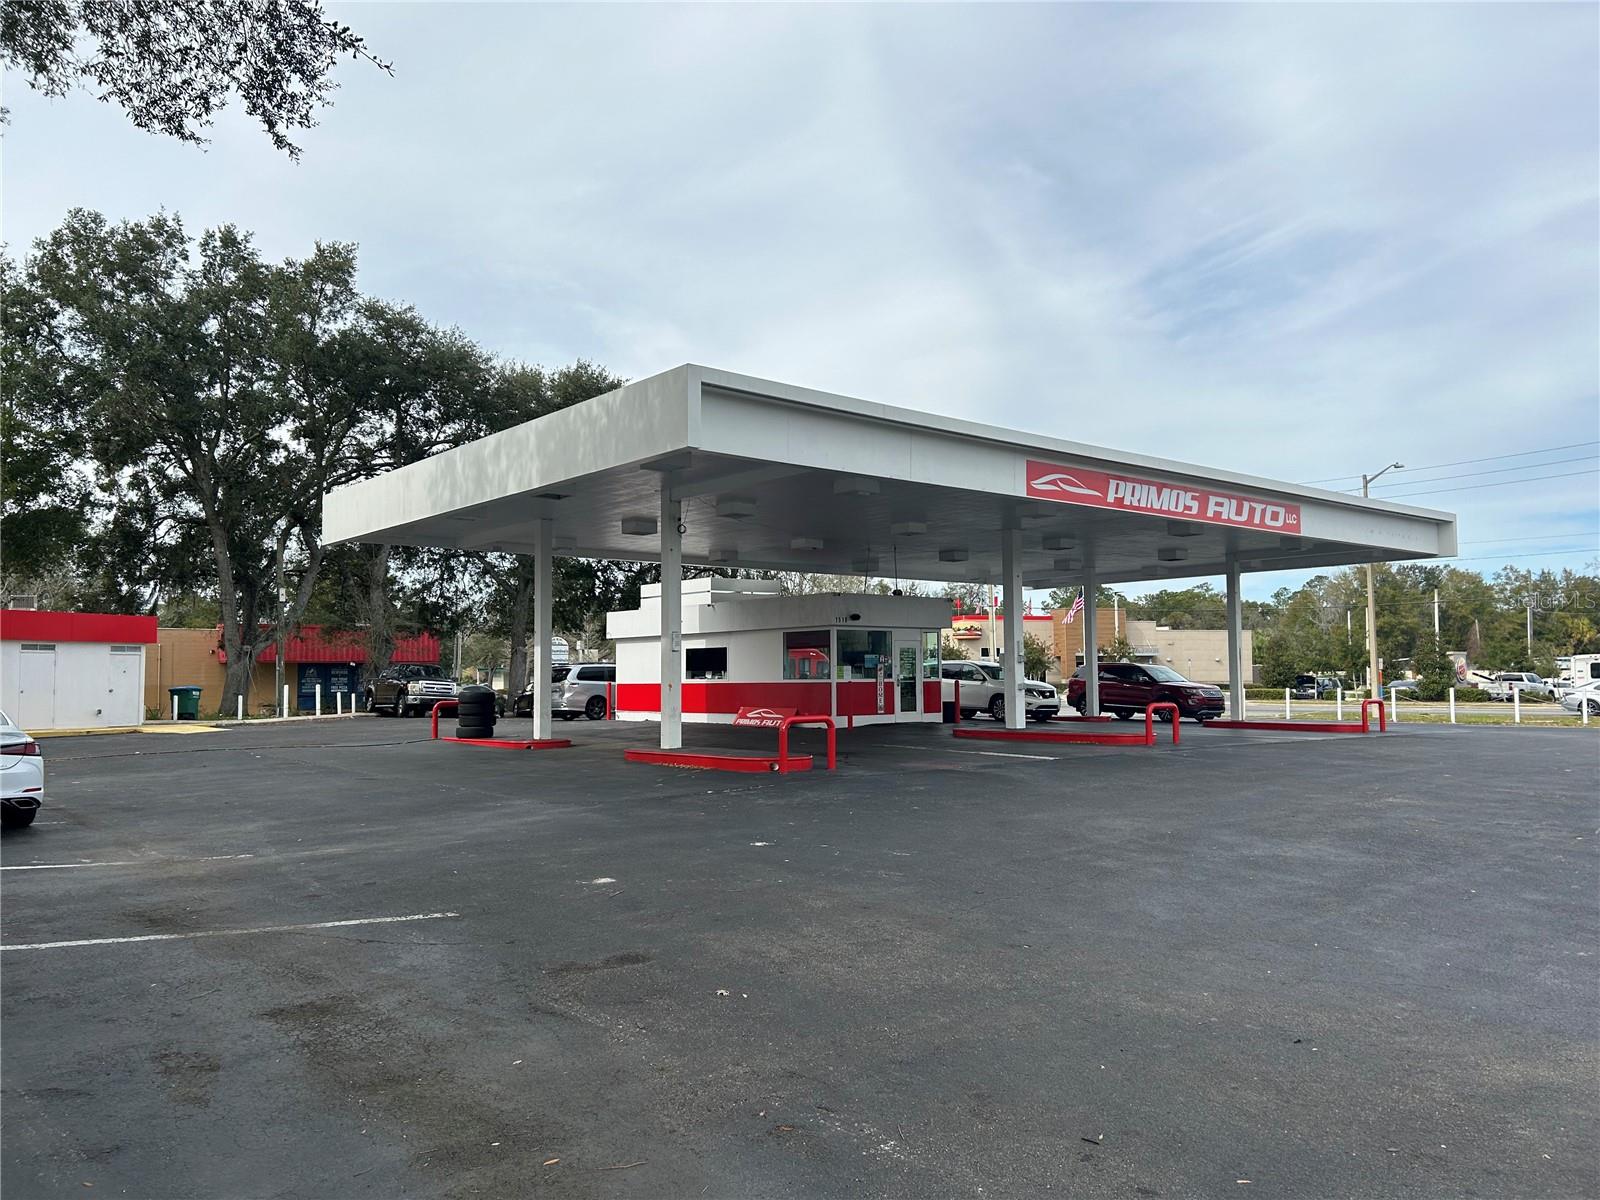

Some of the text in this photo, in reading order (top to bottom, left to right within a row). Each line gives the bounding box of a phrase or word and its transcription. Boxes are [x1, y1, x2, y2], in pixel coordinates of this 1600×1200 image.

[1107, 479, 1297, 527] PRIMOS AUTO LLC
[761, 719, 784, 727] AUT
